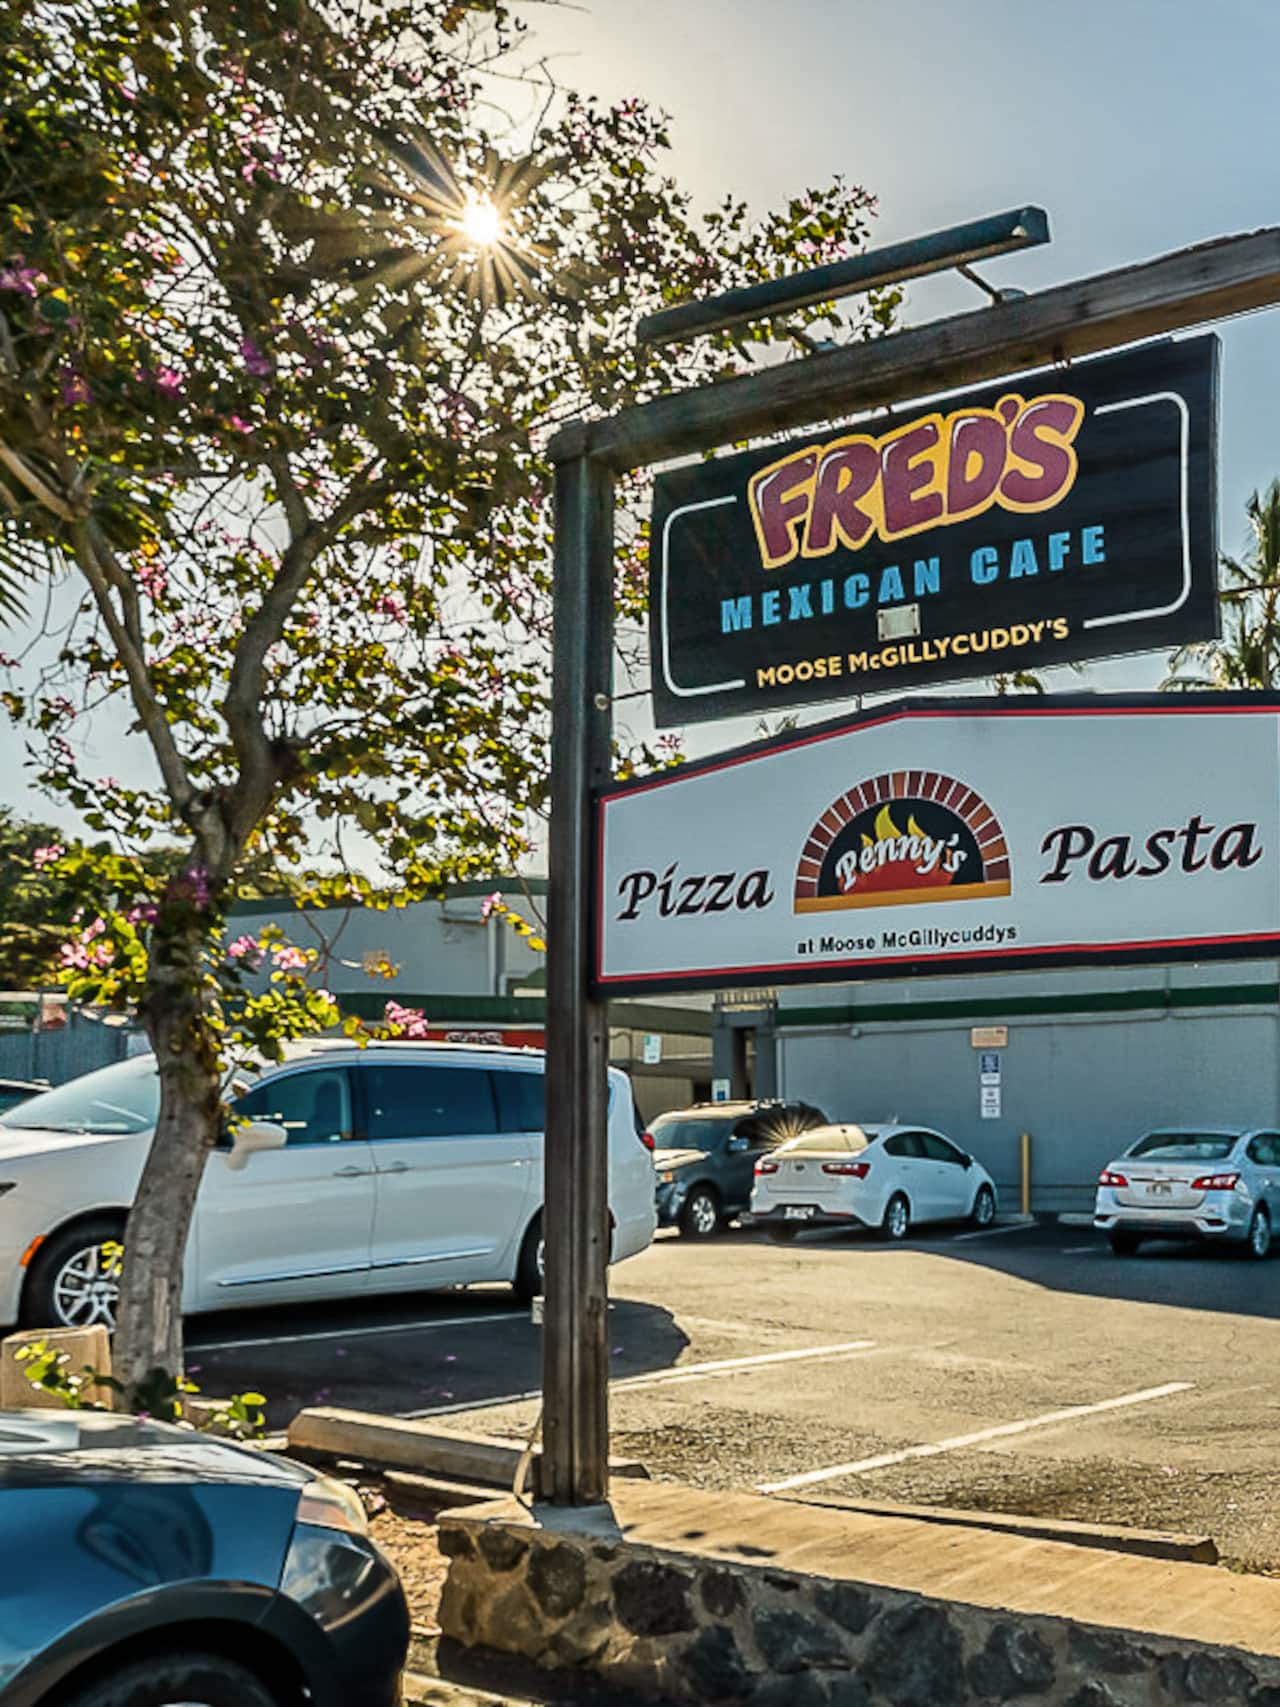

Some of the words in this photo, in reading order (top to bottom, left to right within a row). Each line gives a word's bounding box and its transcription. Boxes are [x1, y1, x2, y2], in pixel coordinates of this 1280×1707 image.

[750, 395, 1082, 566] FRED'S
[720, 557, 941, 634] MEXICAN
[970, 525, 1107, 586] CAFE
[756, 654, 842, 689] MOOSE
[849, 618, 1069, 674] McGILLYCUDDY'S
[834, 820, 968, 892] Penny's
[1039, 815, 1264, 885] Pasta
[617, 862, 774, 920] Pizza
[797, 939, 814, 954] at
[819, 935, 876, 954] Moose
[882, 924, 1017, 951] McGillycuddys
